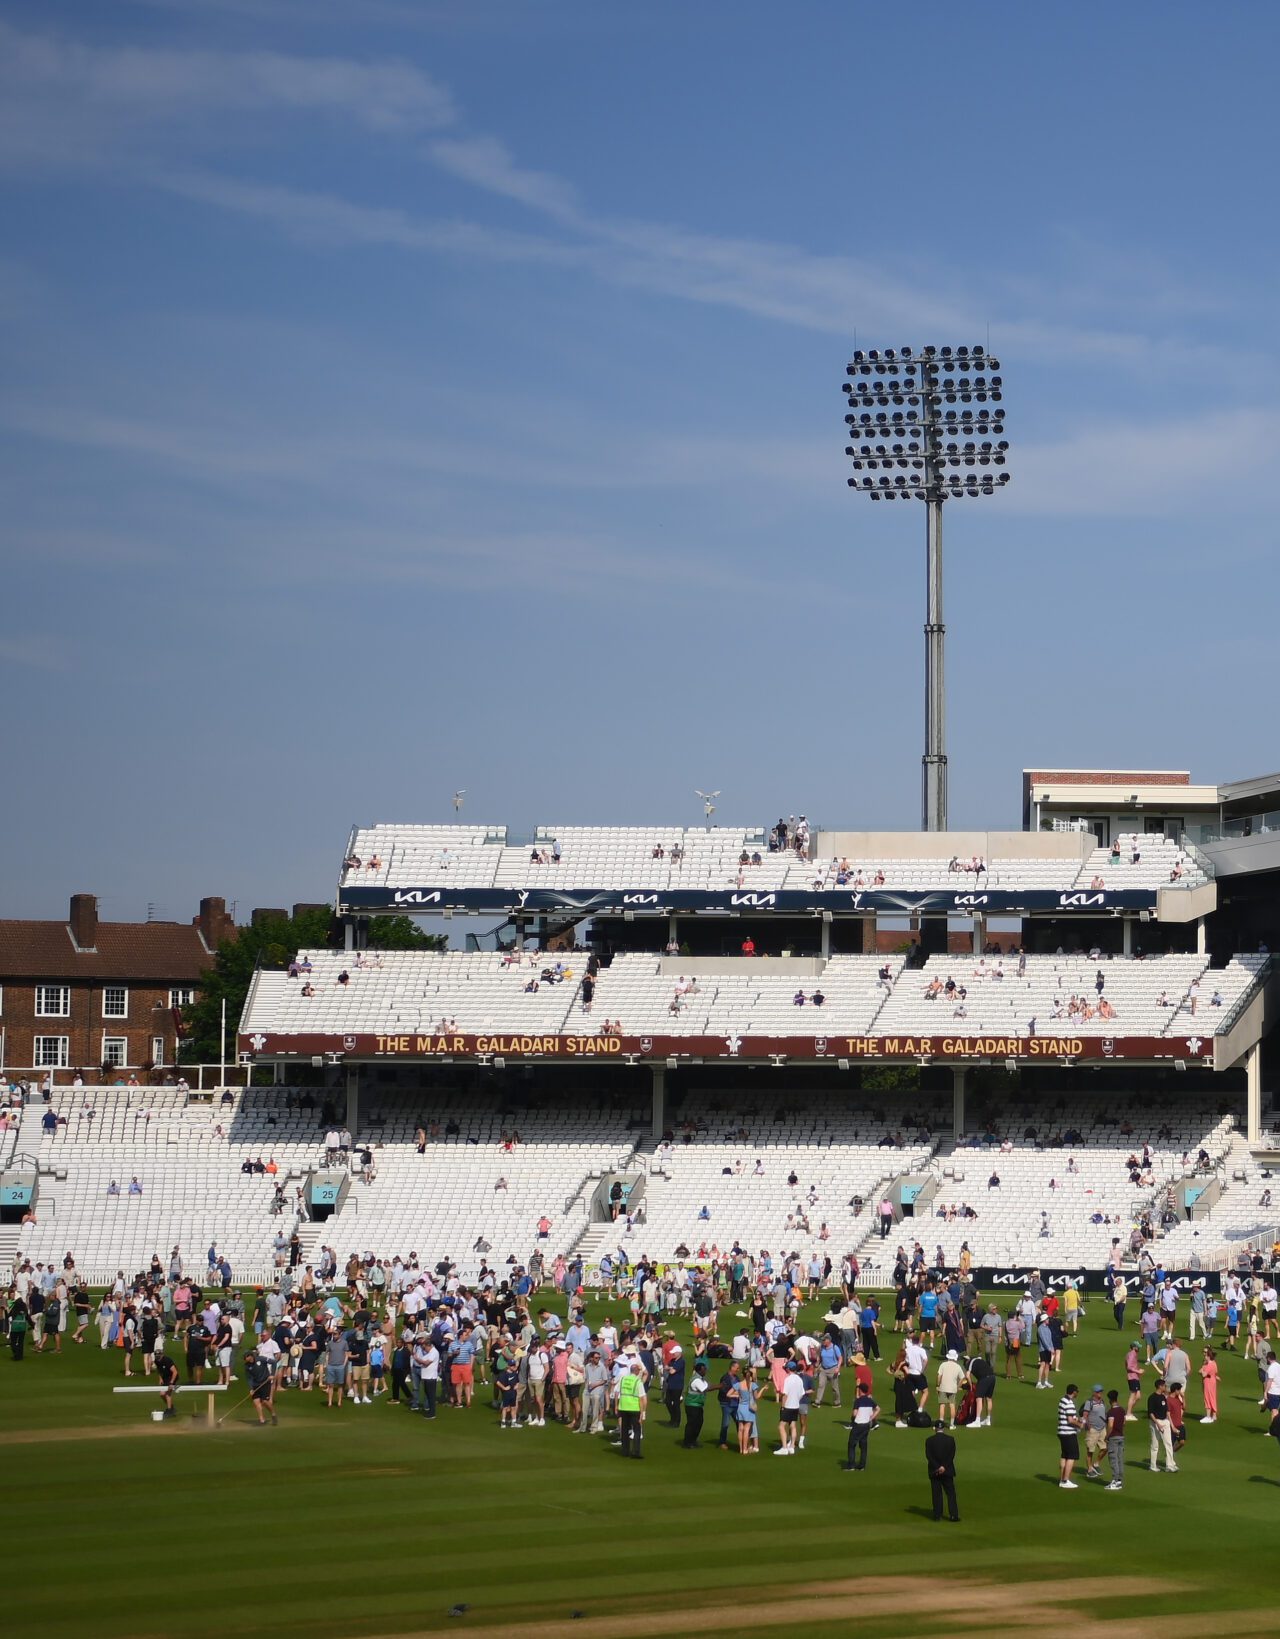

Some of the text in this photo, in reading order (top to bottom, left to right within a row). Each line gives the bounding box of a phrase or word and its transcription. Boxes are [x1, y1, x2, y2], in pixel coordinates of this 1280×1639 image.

[395, 891, 440, 903] KIA
[624, 894, 658, 903] KIA
[731, 893, 776, 905] KIA
[955, 894, 988, 905] KIA
[1060, 893, 1104, 905] KIA
[376, 1036, 621, 1053] THE M.A.R. GALADARI STAND
[846, 1038, 1083, 1055] THE M.A.R. GALADARI STAND
[12, 1191, 23, 1200] 24
[322, 1190, 334, 1199] 25
[993, 1274, 1029, 1284] KIA
[1049, 1275, 1085, 1285] KIA
